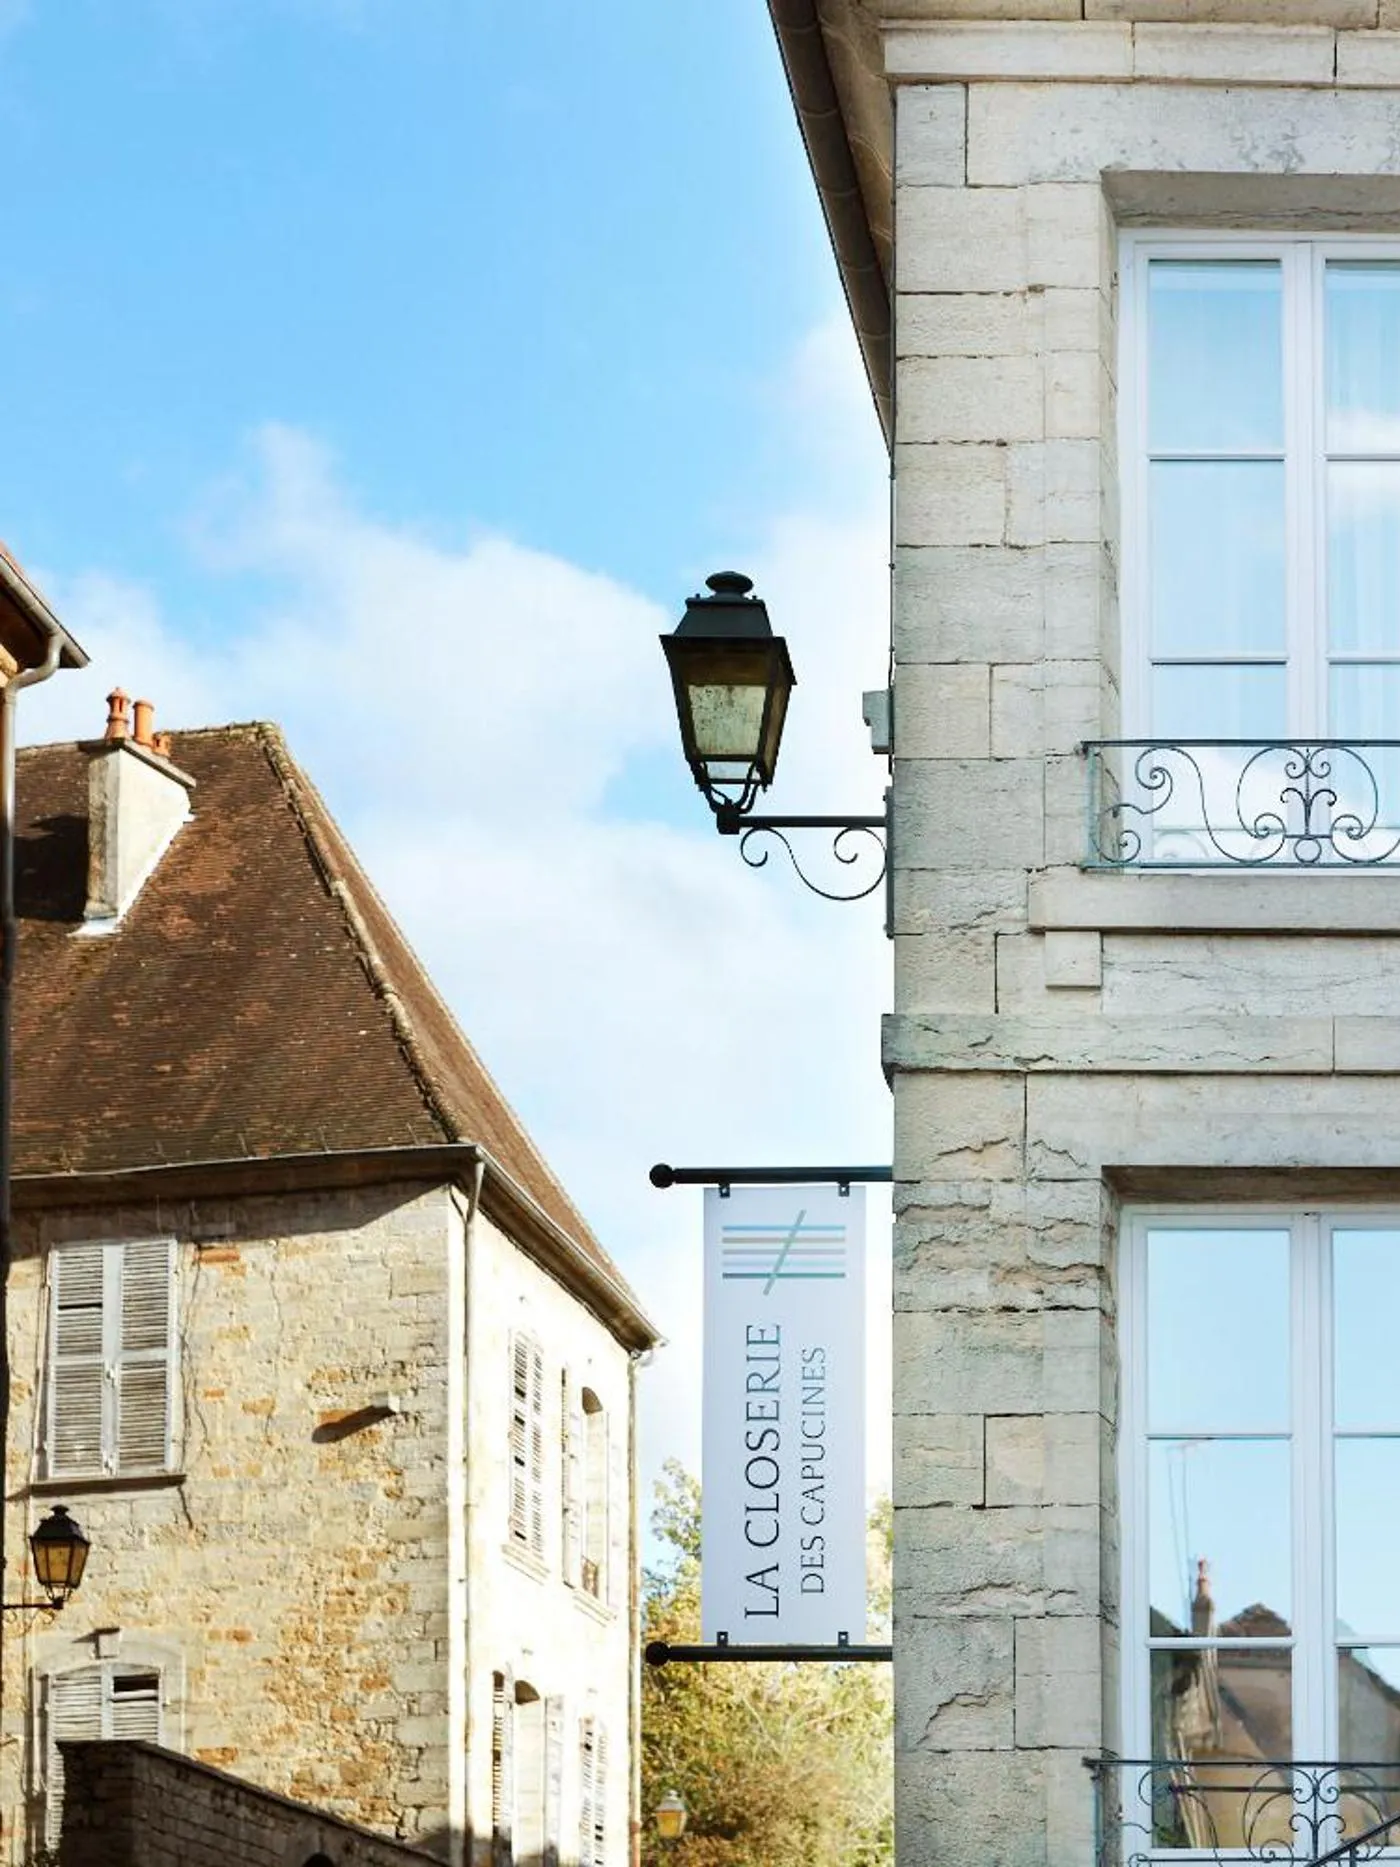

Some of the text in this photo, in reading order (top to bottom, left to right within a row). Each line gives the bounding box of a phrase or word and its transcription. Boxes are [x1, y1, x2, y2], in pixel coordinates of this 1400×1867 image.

[744, 1324, 781, 1619] LA CLOSERIE
[800, 1347, 826, 1595] DES CAPUCINES
